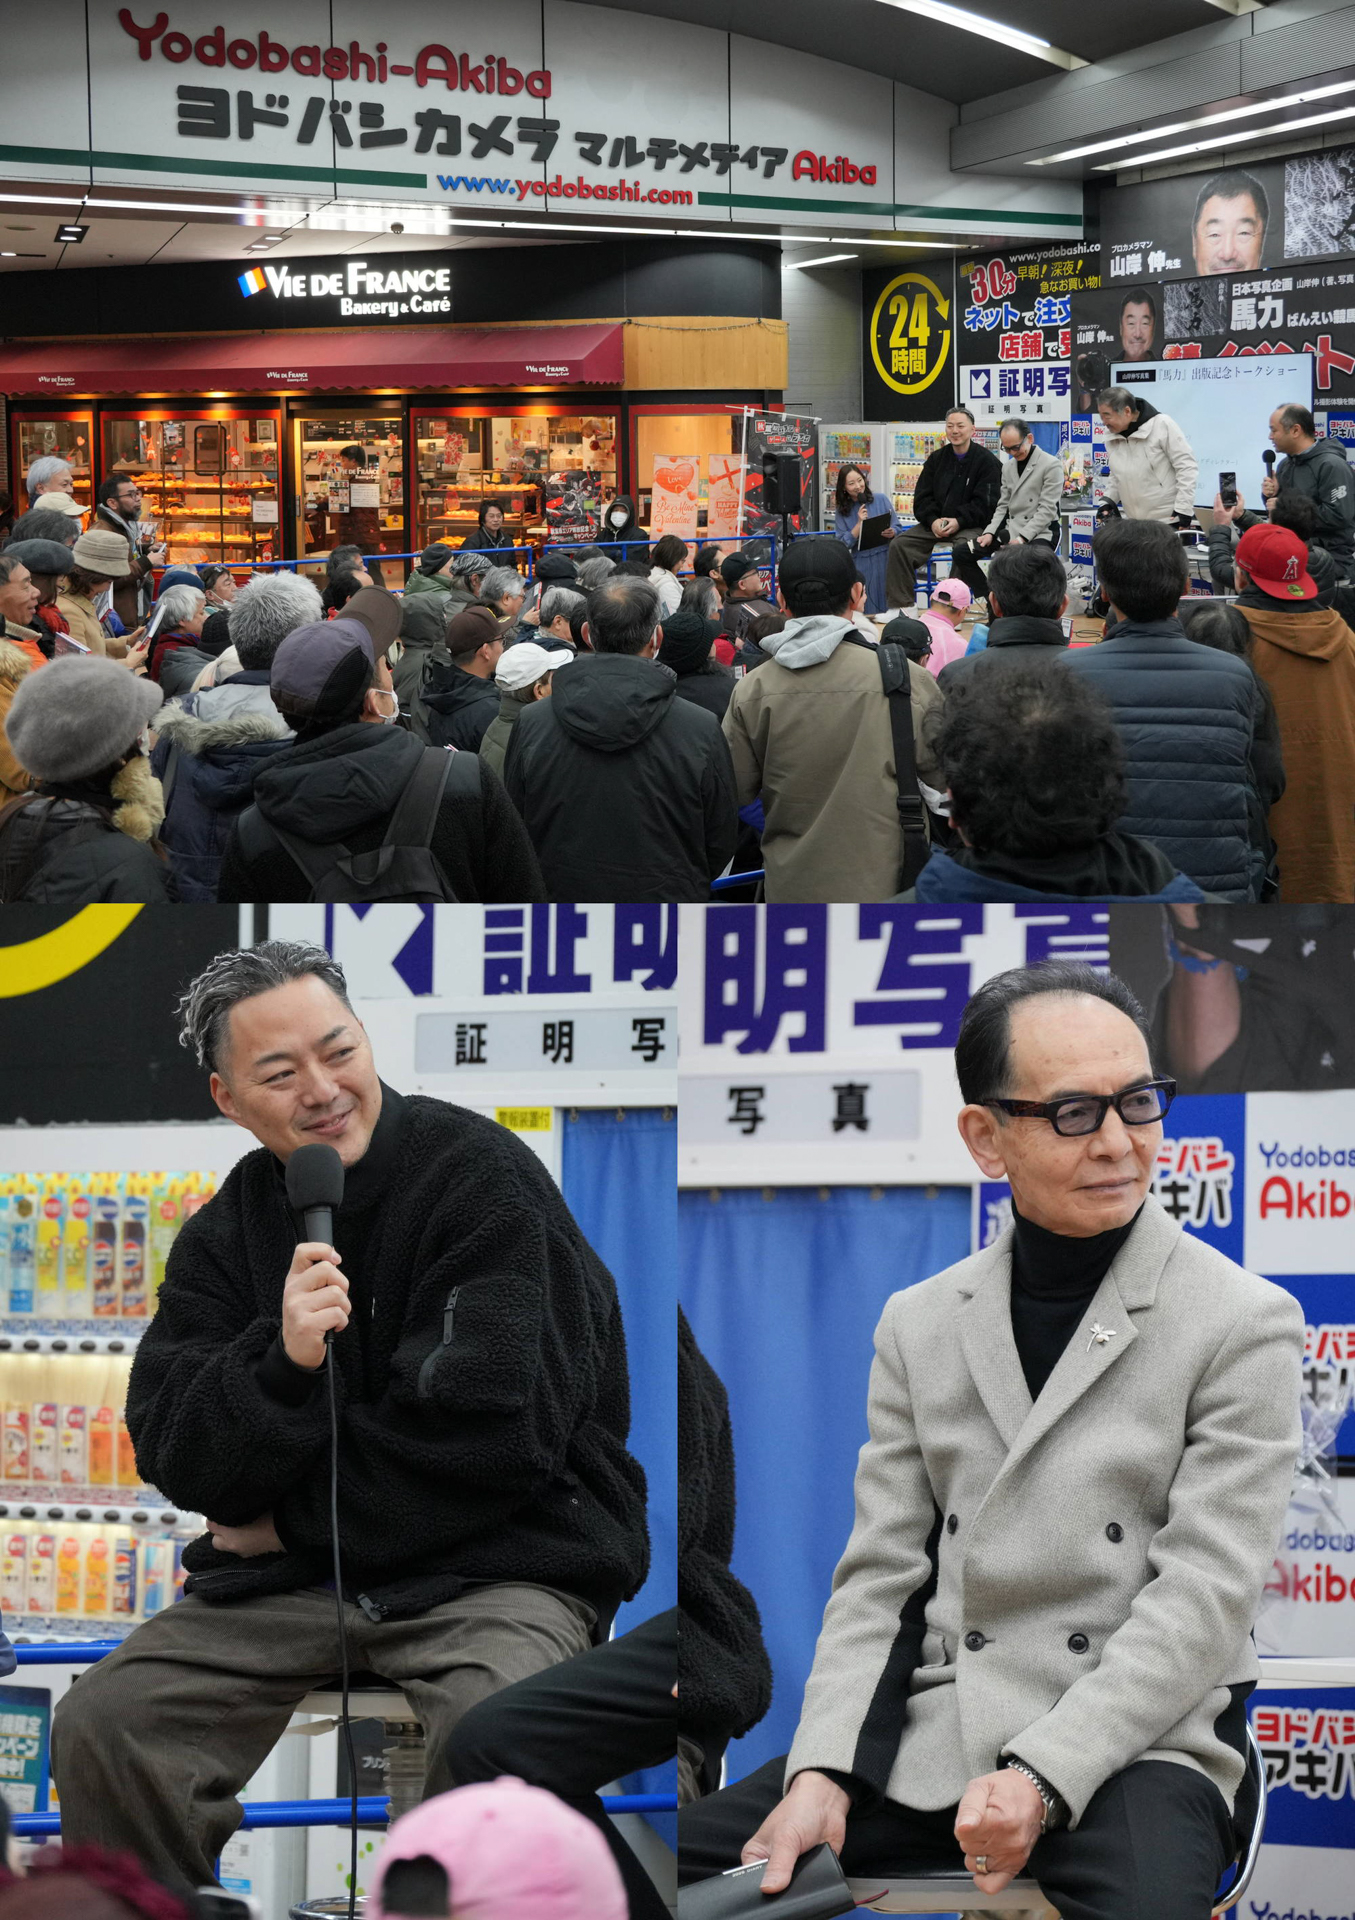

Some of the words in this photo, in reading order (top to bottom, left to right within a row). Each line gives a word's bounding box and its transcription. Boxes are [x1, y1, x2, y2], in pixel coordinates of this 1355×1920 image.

[118, 8, 552, 98] Yodobashi-Akiba
[177, 84, 561, 161] ヨドバシカメラ
[574, 131, 789, 178] マルチメディア
[792, 150, 877, 185] Akiba
[437, 173, 693, 206] www.yodobashi.com
[1111, 241, 1153, 254] プロカメラマン
[1110, 252, 1142, 278] 山岸
[1232, 277, 1293, 297] 日本写真企画
[341, 298, 399, 317] Bakery
[410, 295, 450, 313] Café
[889, 293, 930, 348] 24
[1230, 295, 1284, 331] 馬力
[1077, 330, 1095, 344] 山岸
[891, 348, 927, 375] 時間
[1260, 1176, 1355, 1219] Akib
